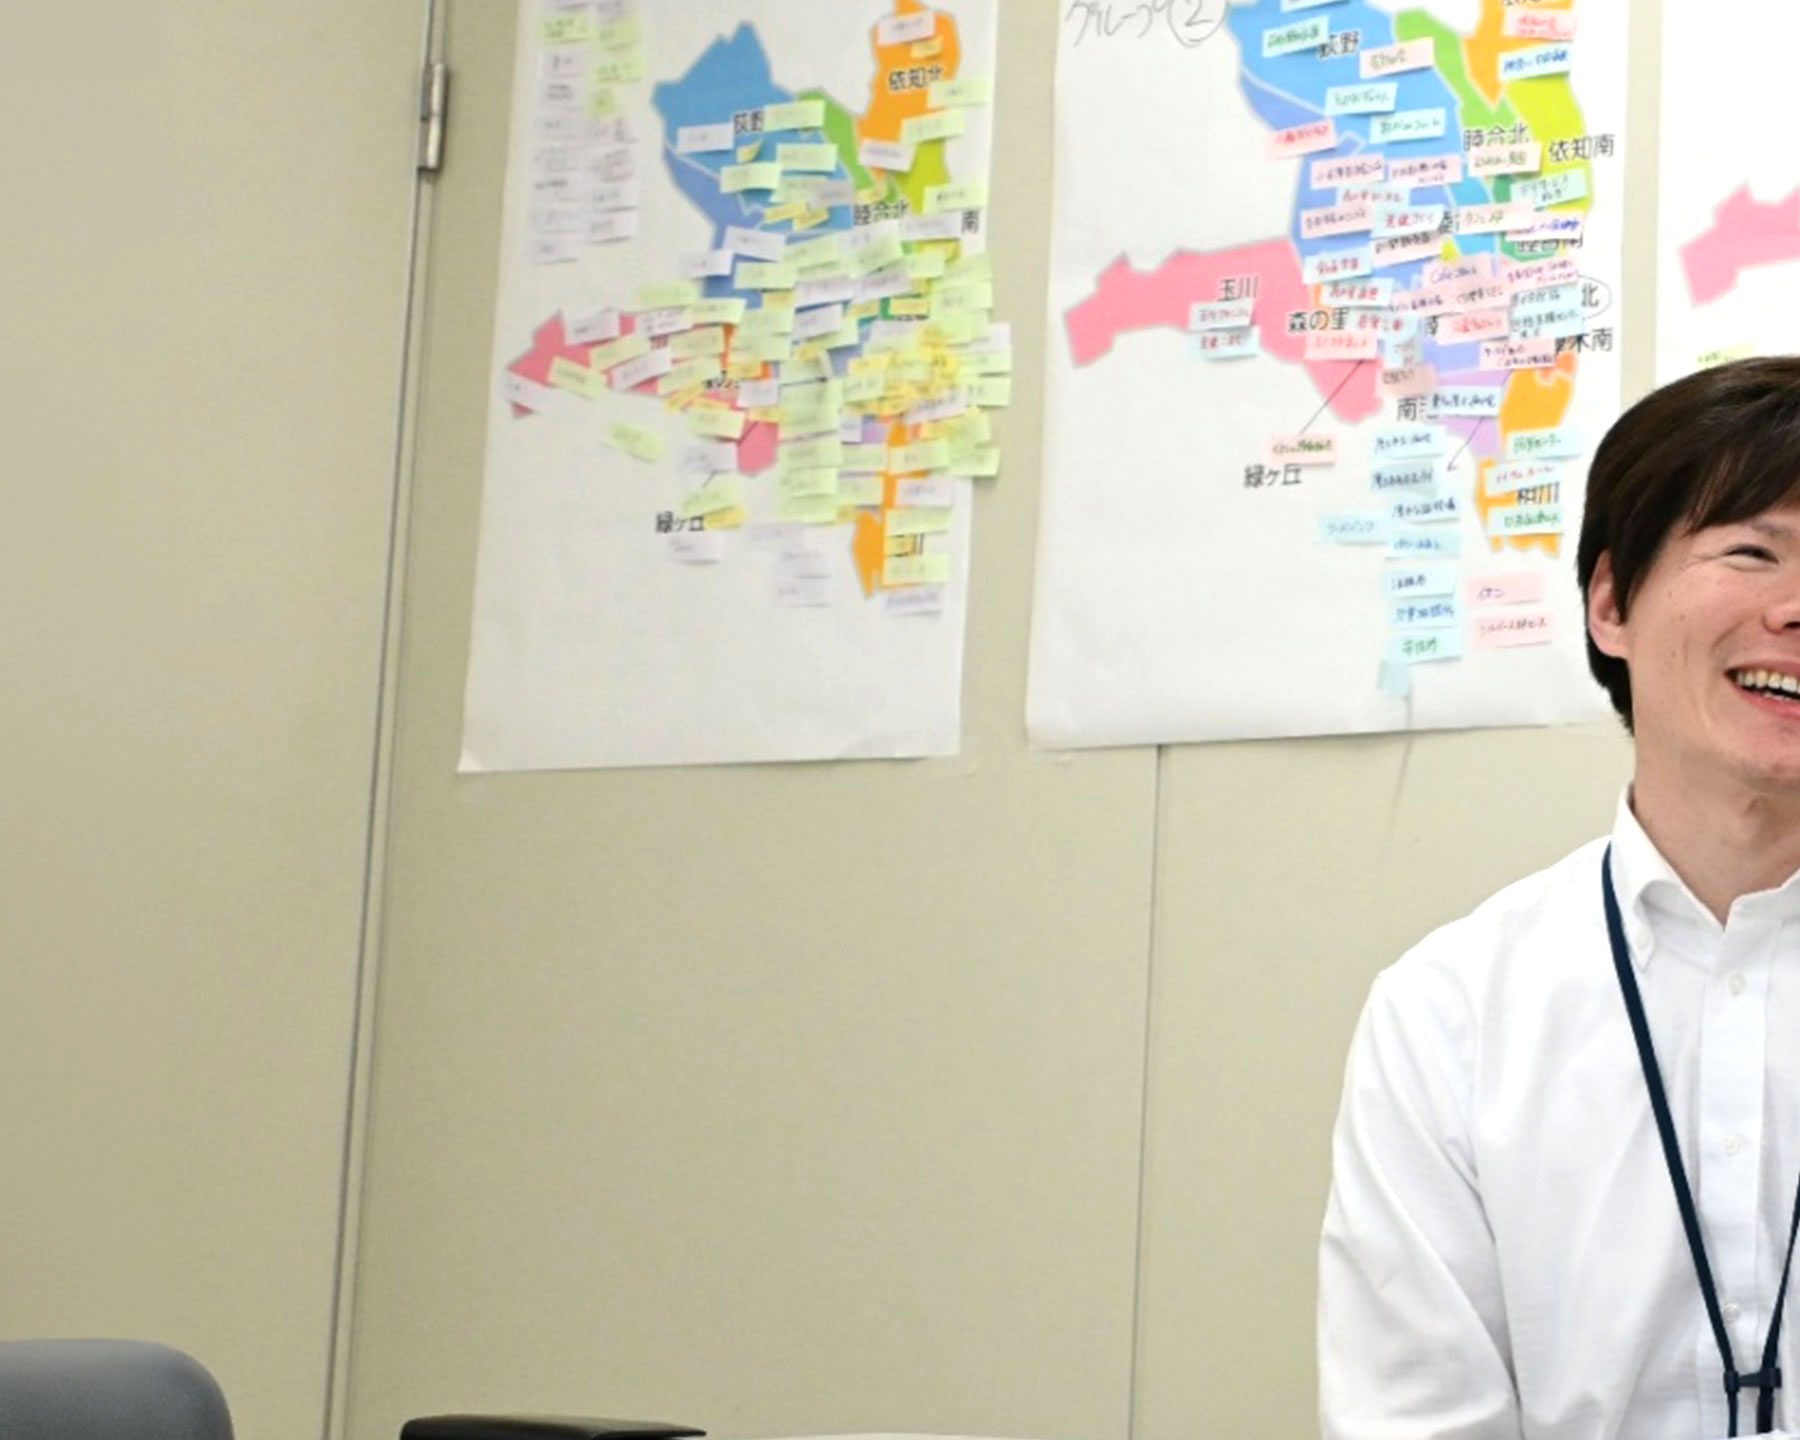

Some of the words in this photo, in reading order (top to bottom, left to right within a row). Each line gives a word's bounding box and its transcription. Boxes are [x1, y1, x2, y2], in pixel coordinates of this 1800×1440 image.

[1549, 134, 1615, 161] 依知南
[1218, 276, 1258, 302] 玉川
[1288, 307, 1349, 332] 森の里
[1244, 464, 1302, 489] 緑ヶ丘
